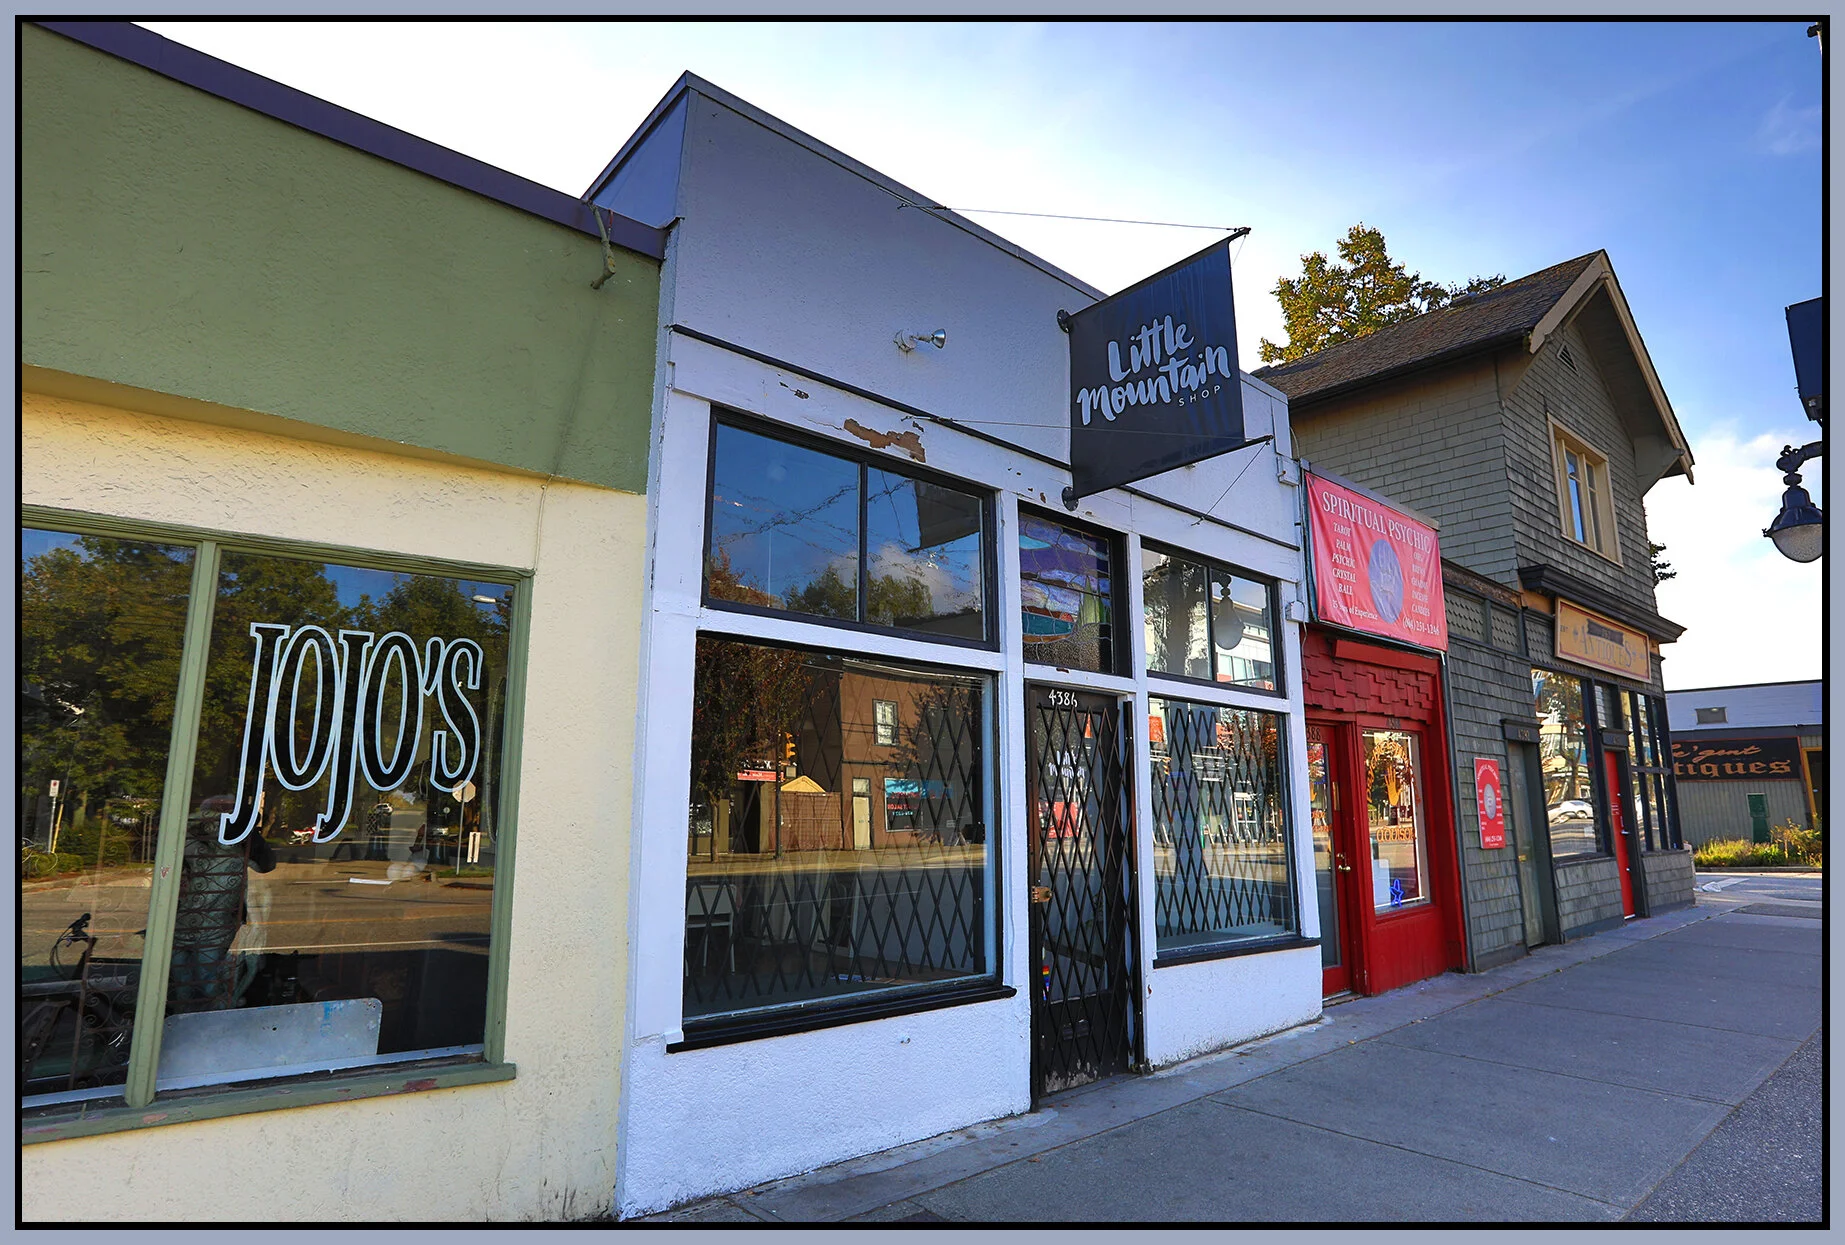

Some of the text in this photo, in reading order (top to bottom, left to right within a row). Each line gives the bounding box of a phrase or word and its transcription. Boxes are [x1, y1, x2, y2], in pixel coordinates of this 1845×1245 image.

[1107, 314, 1194, 382] Little
[1178, 384, 1222, 407] SHOP
[1322, 491, 1431, 554] SPIRITUAL PSYCHIC
[1333, 522, 1352, 537] TAROT
[1336, 539, 1352, 551] PALM
[1332, 553, 1356, 569] PSYCHIC
[1332, 568, 1357, 583] CRYSTAL
[1338, 583, 1353, 596] BALL
[1354, 606, 1378, 620] Experience
[218, 622, 484, 845] JOJO'S
